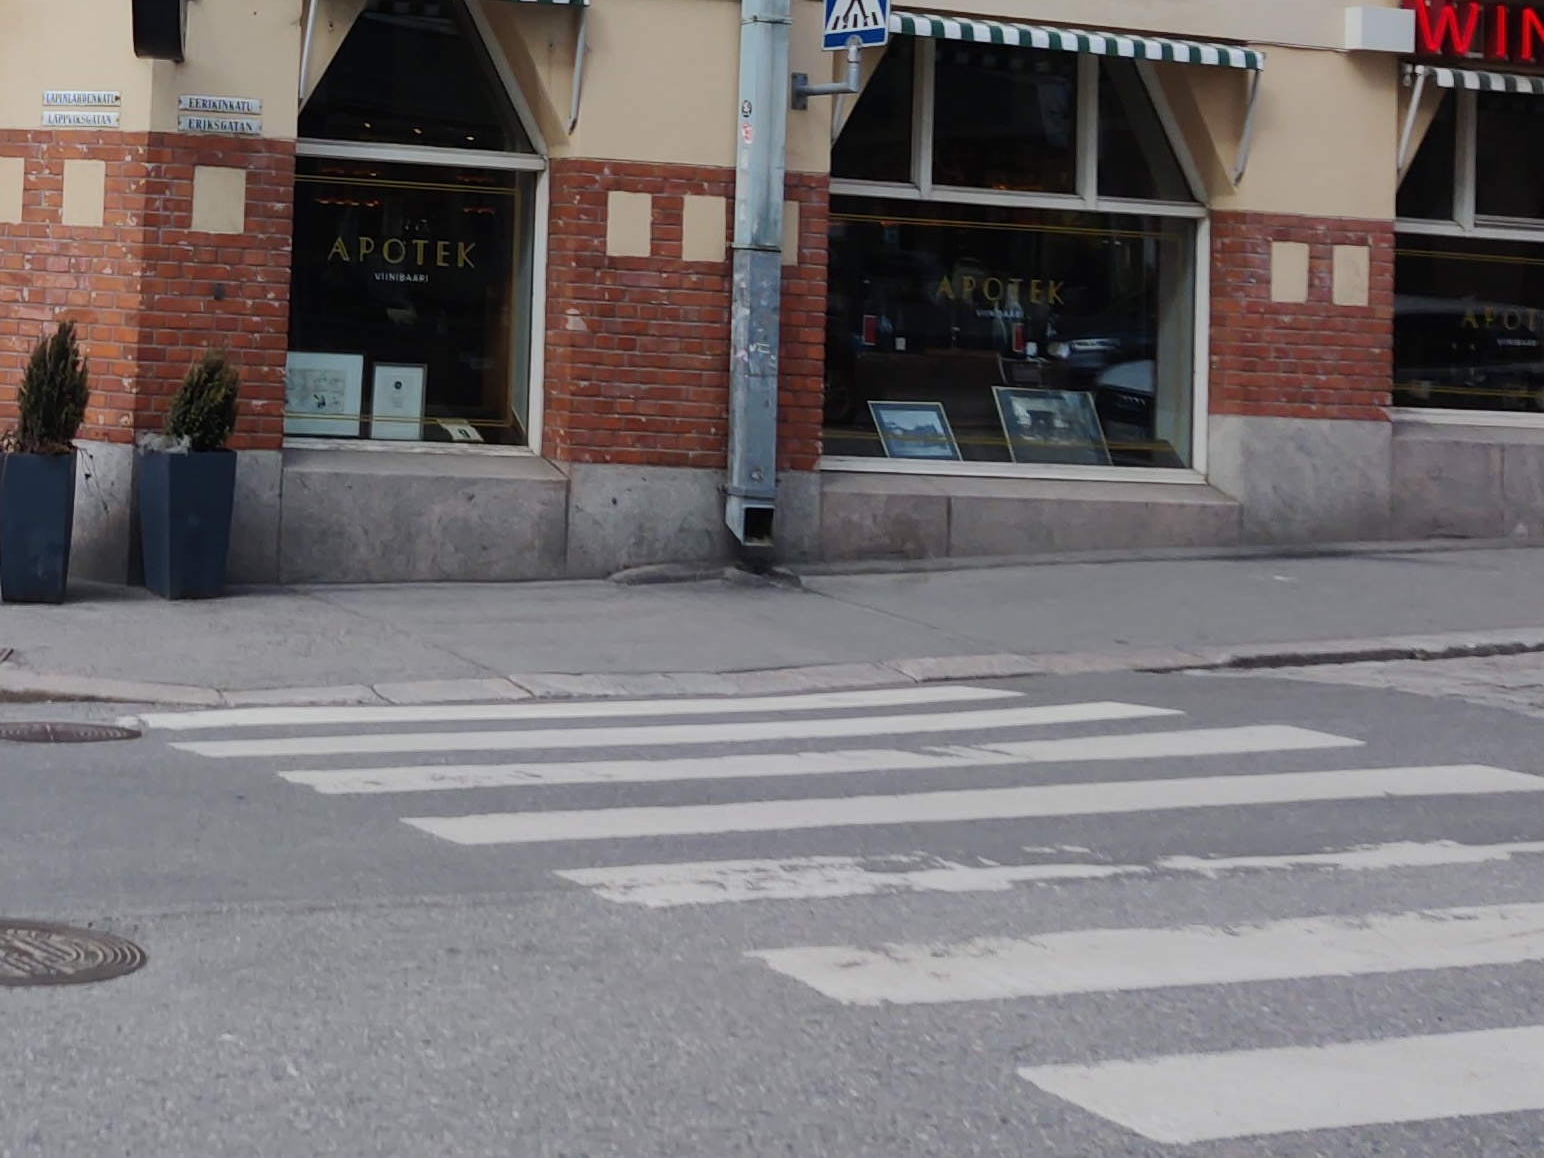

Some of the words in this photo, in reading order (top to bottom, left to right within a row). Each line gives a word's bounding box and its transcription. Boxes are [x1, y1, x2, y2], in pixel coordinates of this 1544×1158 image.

[189, 97, 253, 112] EERIKINKATU
[188, 118, 253, 132] ERIKSGATAN
[327, 235, 476, 269] APOTEK
[936, 275, 1064, 305] APOTEK
